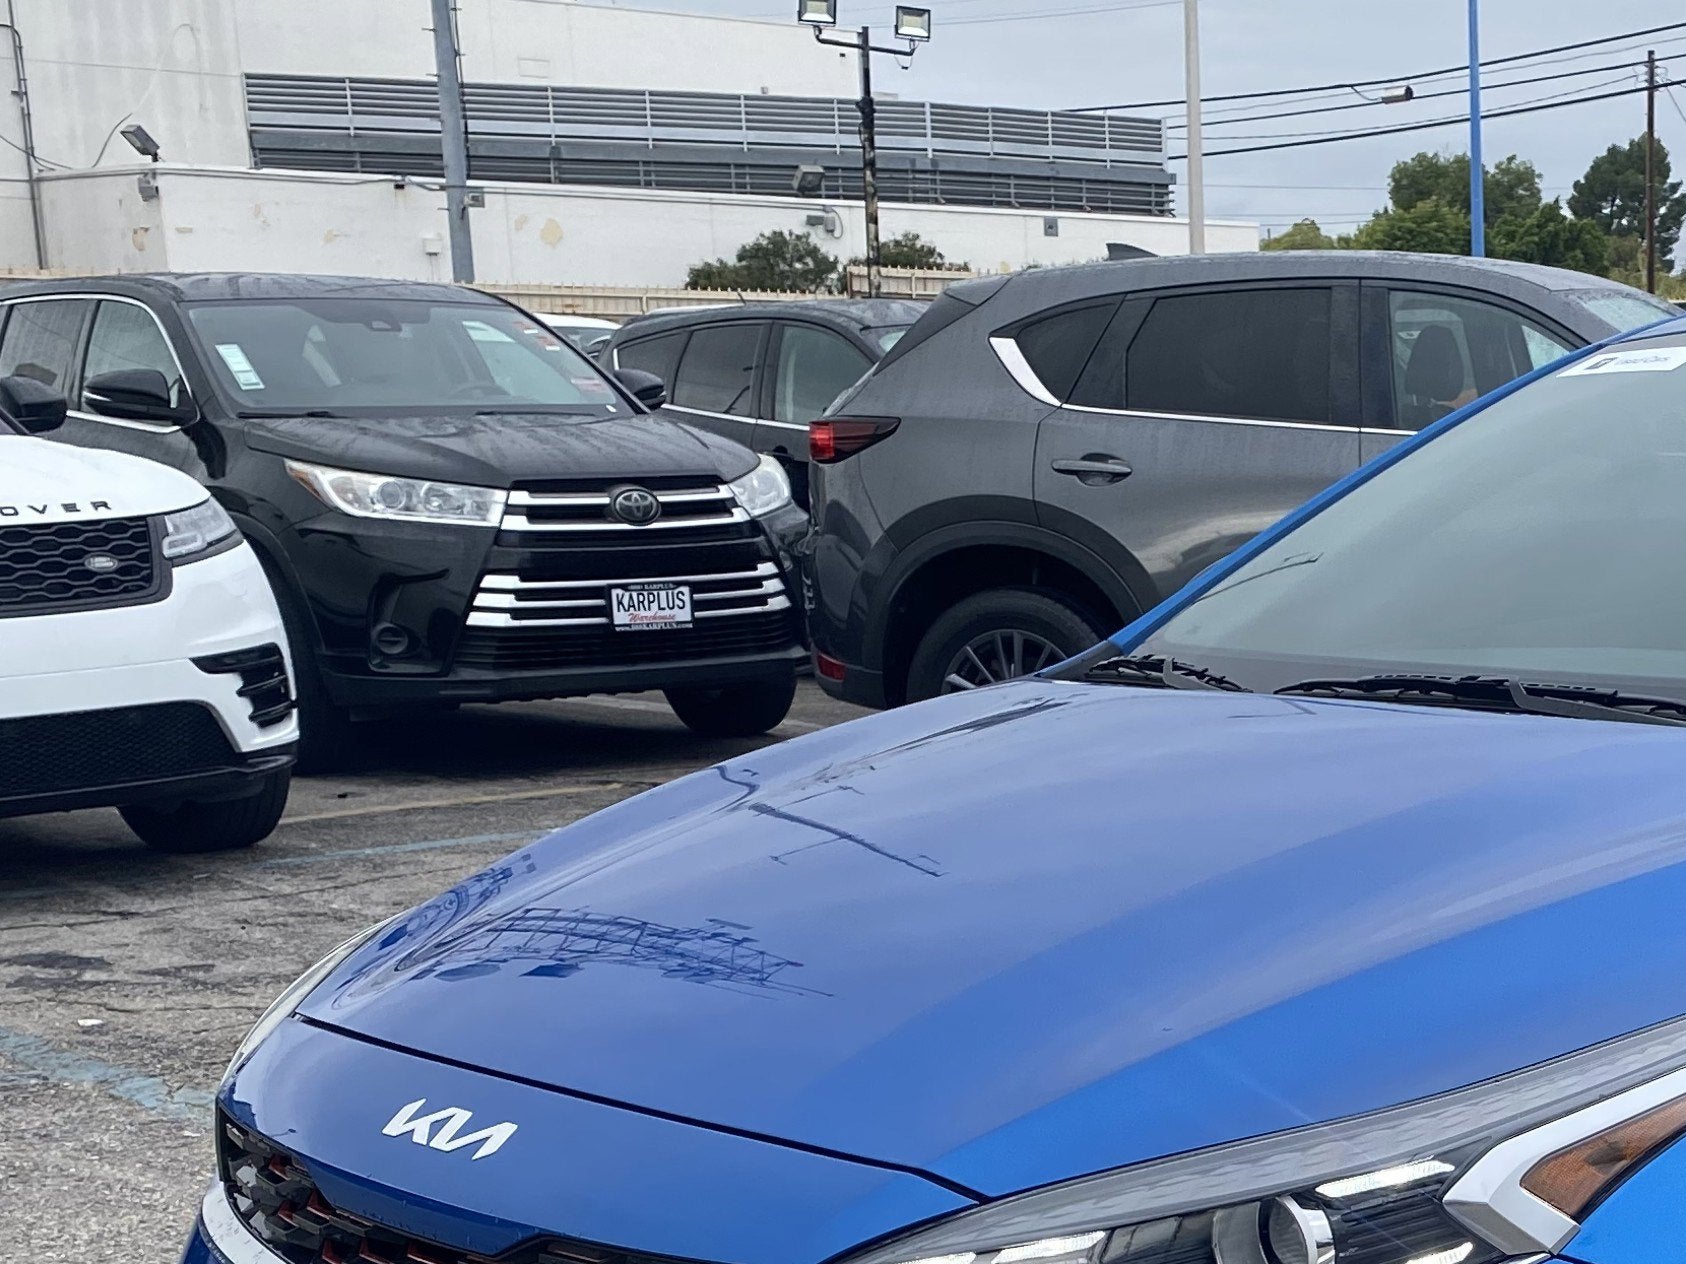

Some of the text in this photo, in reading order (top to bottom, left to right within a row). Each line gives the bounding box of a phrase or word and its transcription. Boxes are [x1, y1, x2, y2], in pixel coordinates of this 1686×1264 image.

[0, 501, 111, 516] OVER
[616, 591, 686, 612] KARPLUS
[382, 1098, 518, 1161] KIA
